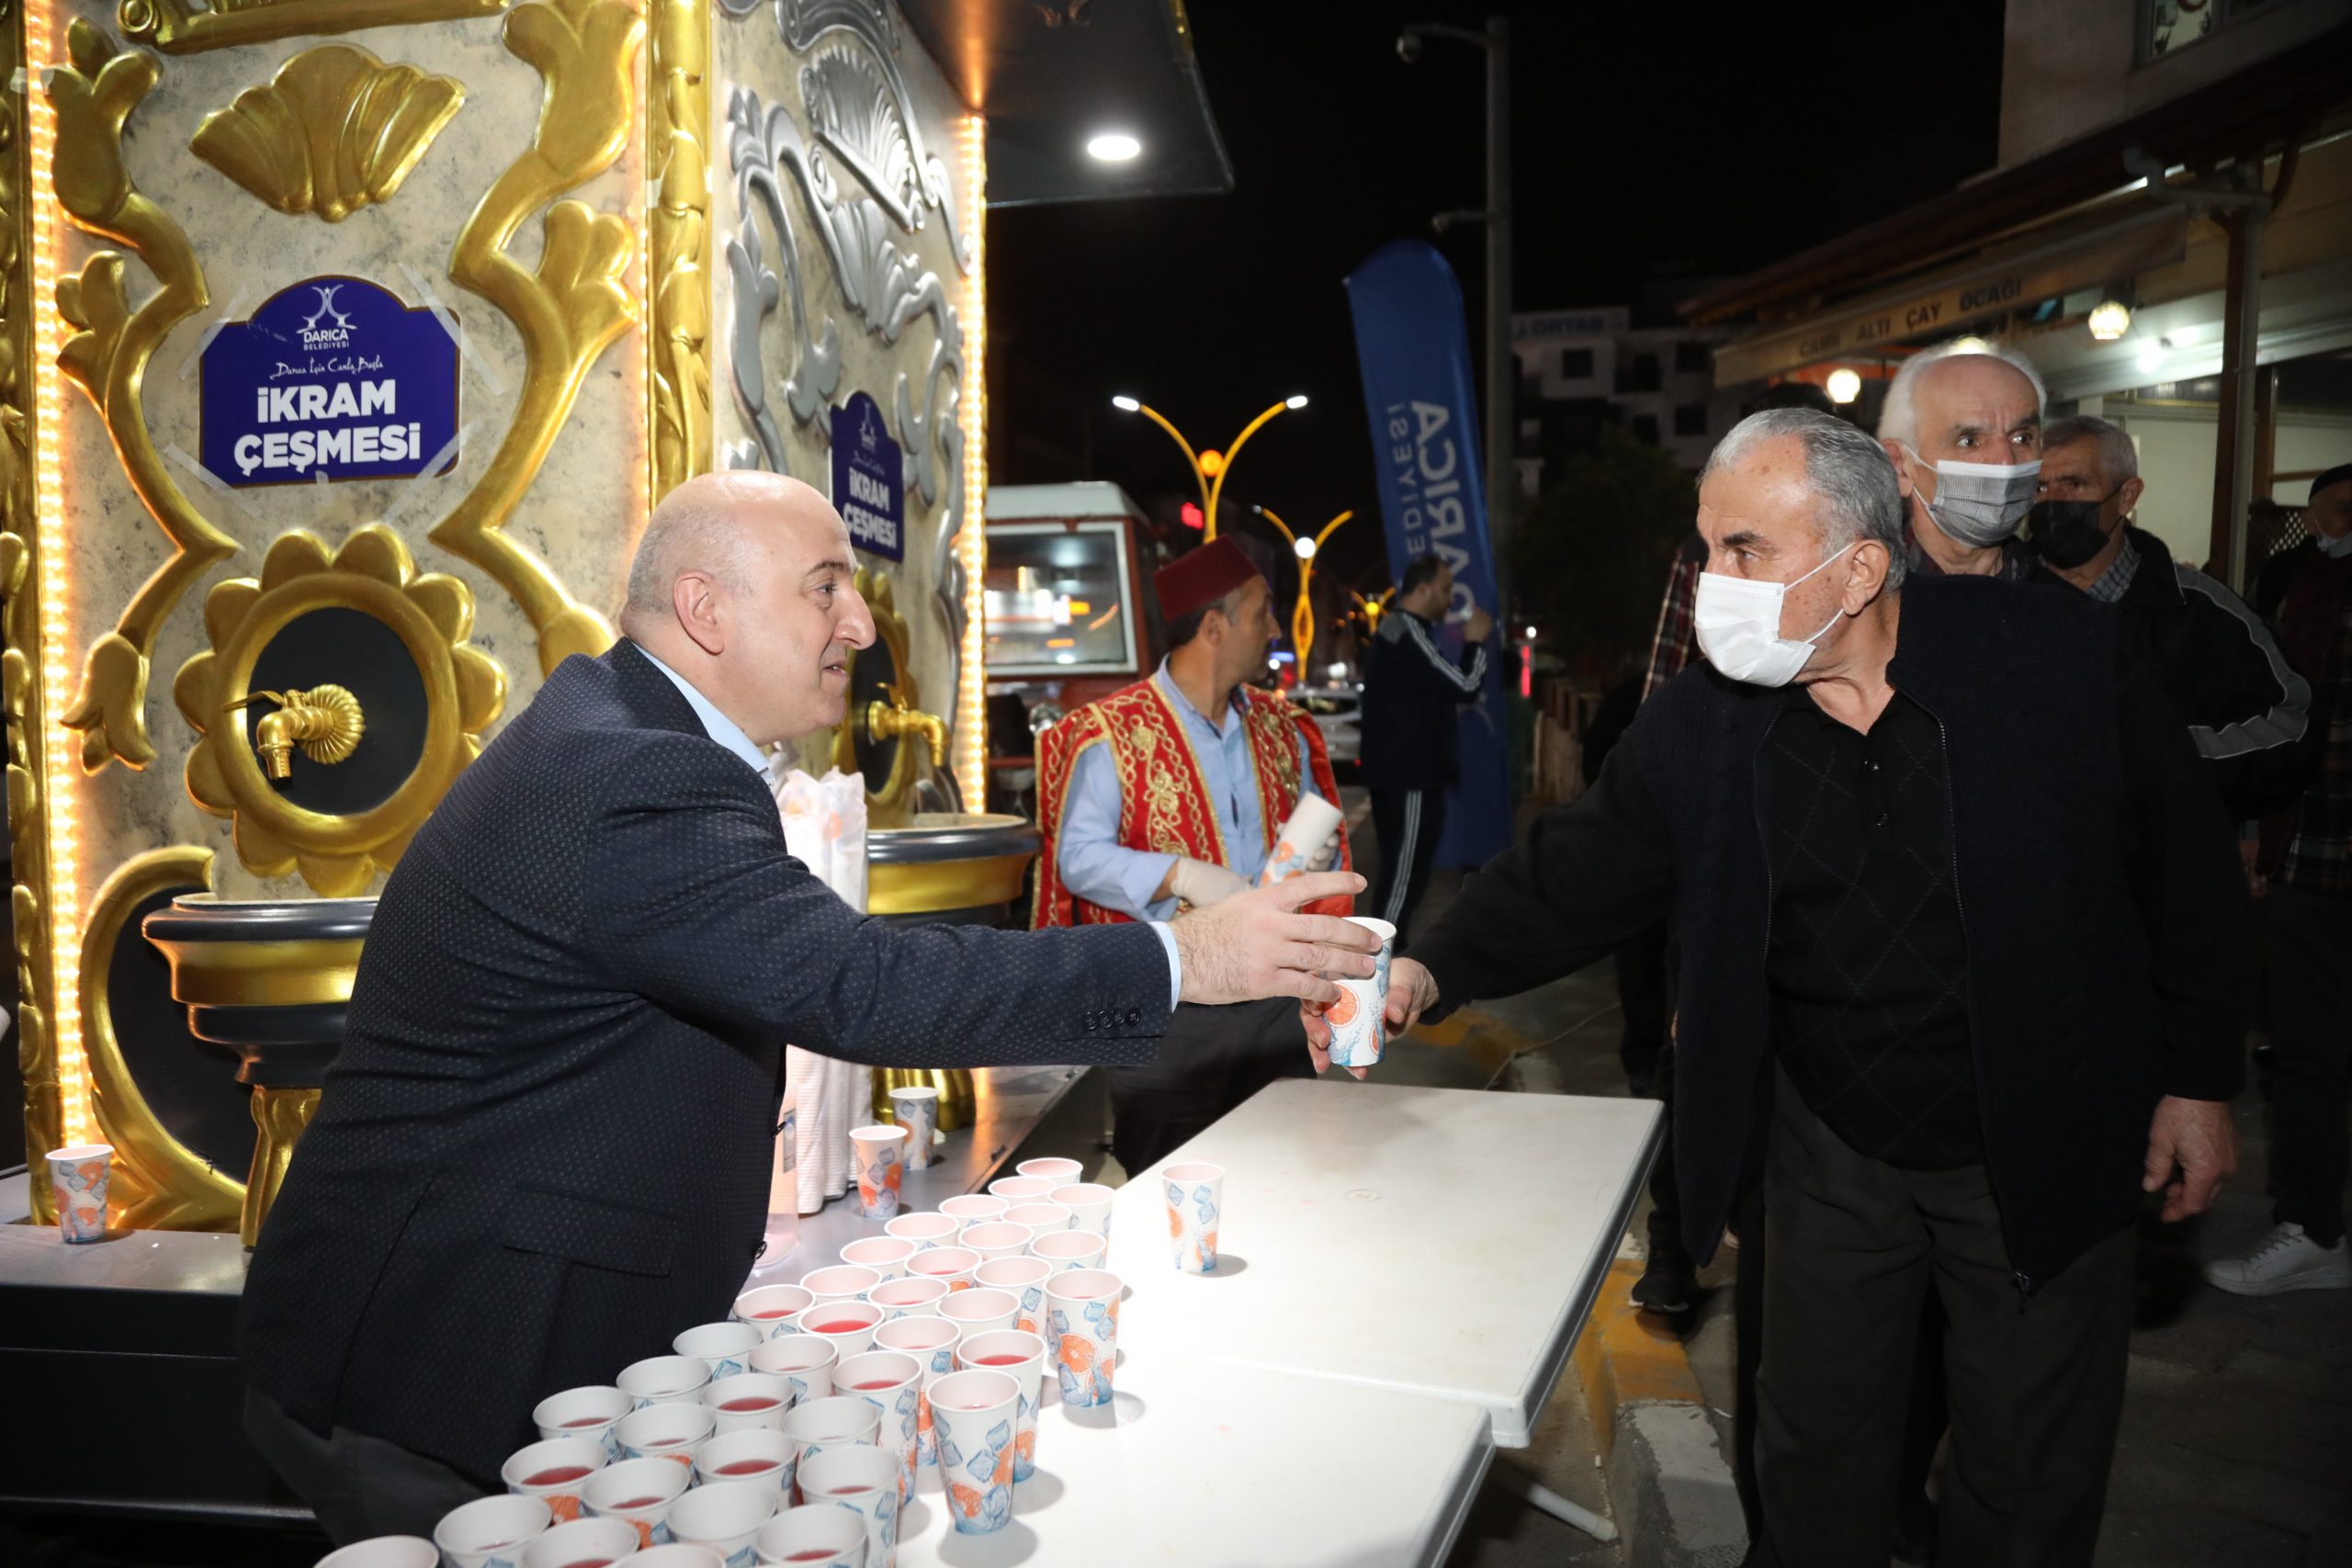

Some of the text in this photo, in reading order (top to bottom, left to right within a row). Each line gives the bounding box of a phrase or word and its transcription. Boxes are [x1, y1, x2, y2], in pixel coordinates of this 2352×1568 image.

[303, 329, 349, 344] DARICA
[1857, 318, 1891, 341] ALTI
[1905, 301, 1941, 331] ÇAY
[257, 379, 396, 423] İKRAM
[233, 423, 421, 477] ÇEŞMESİ
[848, 467, 890, 512] İKRAM
[842, 502, 897, 549] ÇEŞMESİ
